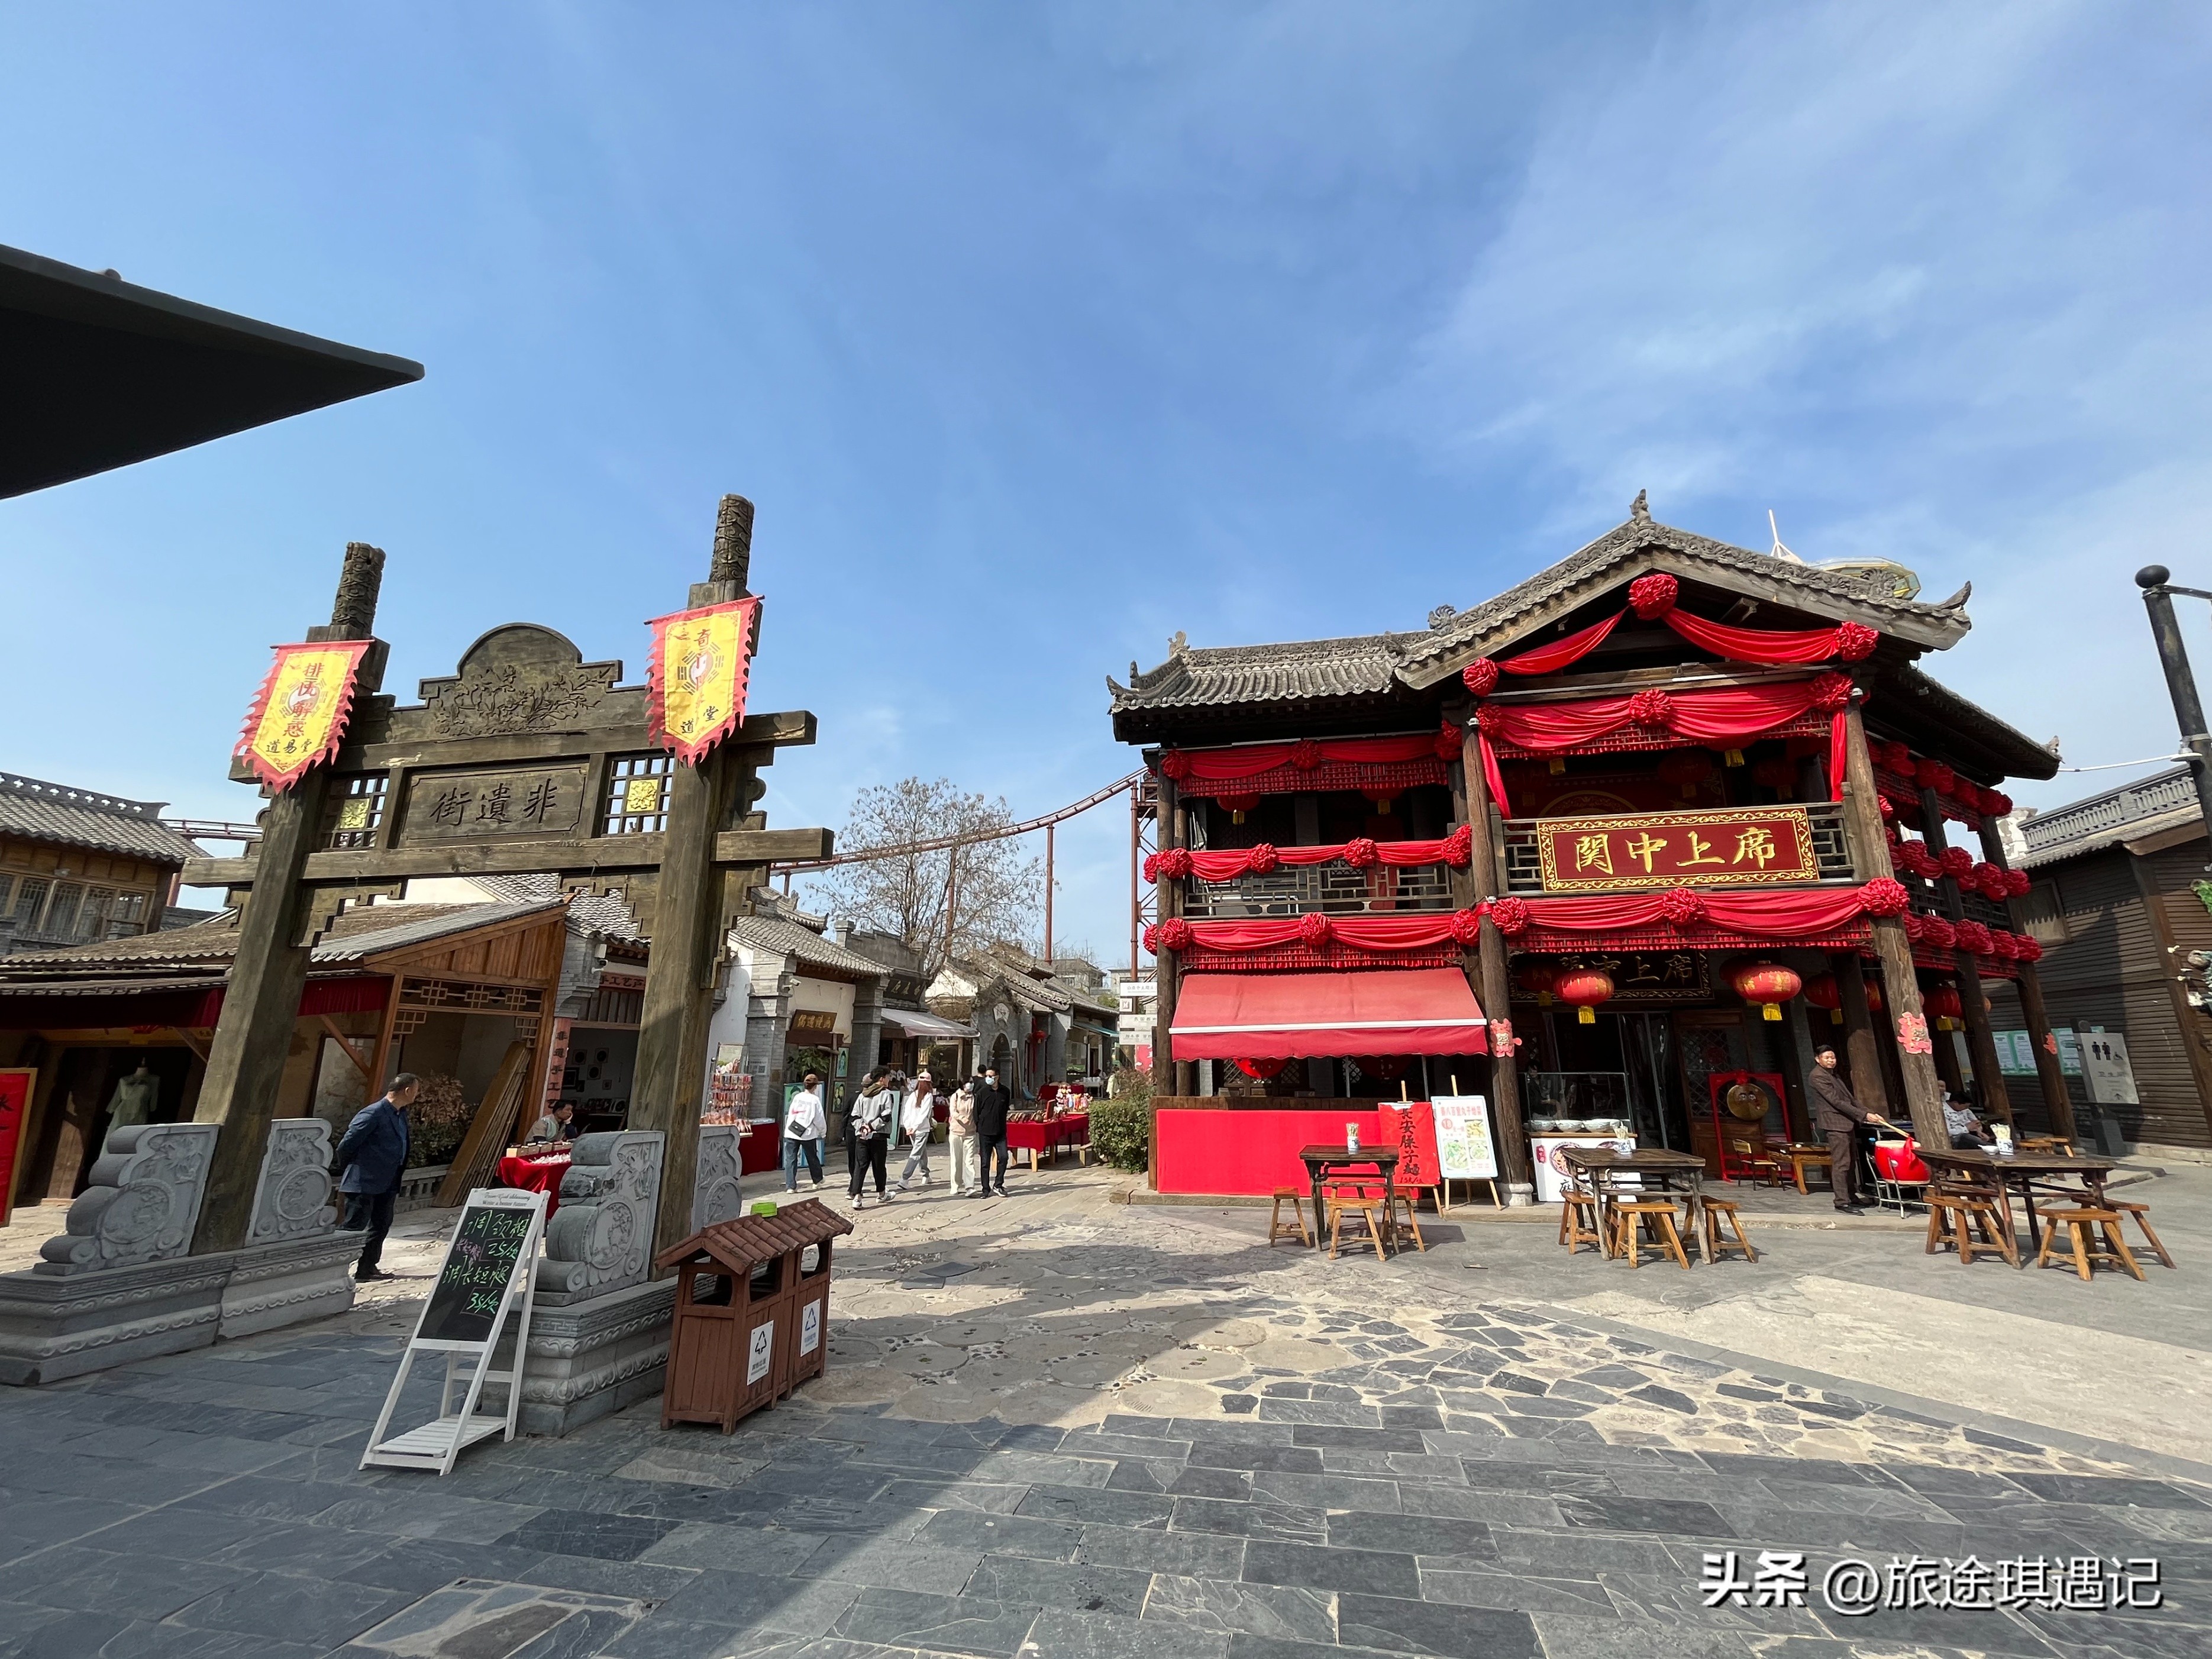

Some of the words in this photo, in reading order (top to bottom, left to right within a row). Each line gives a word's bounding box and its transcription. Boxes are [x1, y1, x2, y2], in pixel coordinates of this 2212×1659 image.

[680, 706, 719, 734] 道堂
[266, 738, 312, 754] 道易堂
